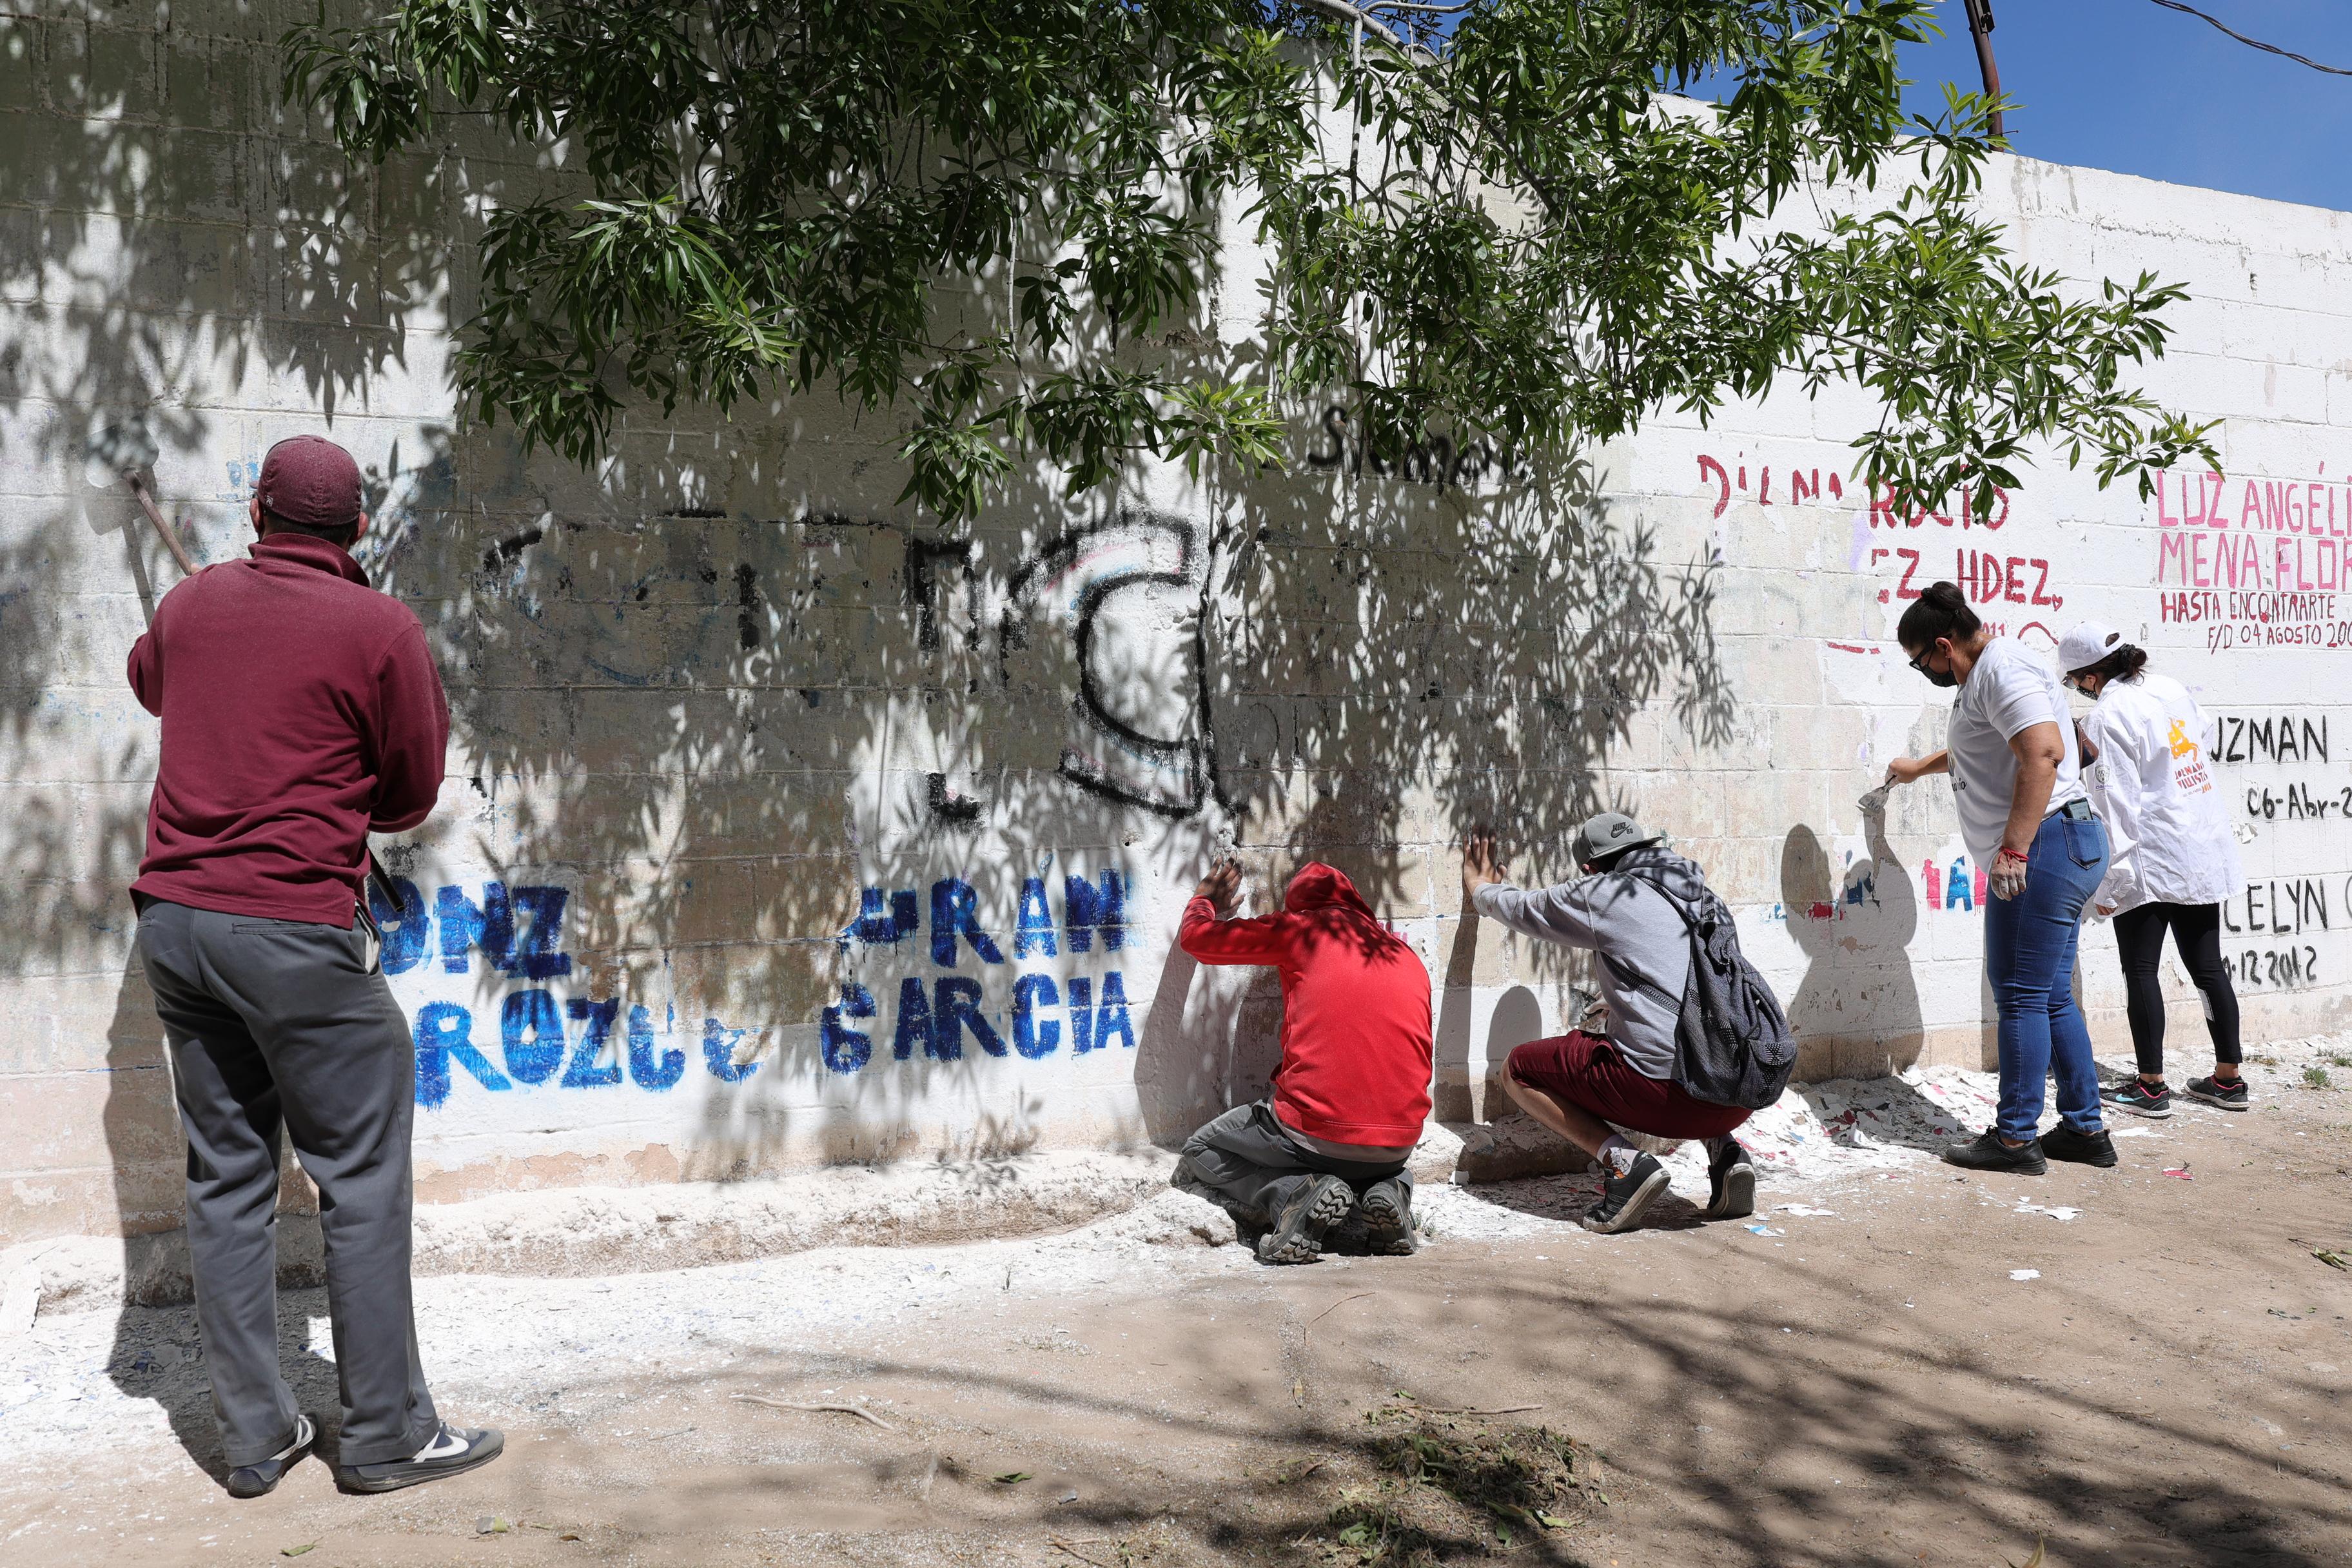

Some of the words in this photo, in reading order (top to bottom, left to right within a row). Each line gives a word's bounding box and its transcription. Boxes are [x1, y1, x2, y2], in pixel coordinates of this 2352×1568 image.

[2157, 469, 2228, 528] LUZ
[1957, 548, 2052, 605] HDEZ
[2159, 532, 2261, 589] MENA
[2161, 591, 2220, 623] HASTA
[2230, 592, 2336, 624] ENCONTRARTE
[2208, 623, 2233, 654] F/D
[2241, 623, 2261, 646] 04
[2267, 624, 2321, 645] AGOSTO
[2209, 715, 2328, 763] UZMAN
[1612, 822, 1627, 832] NIKE
